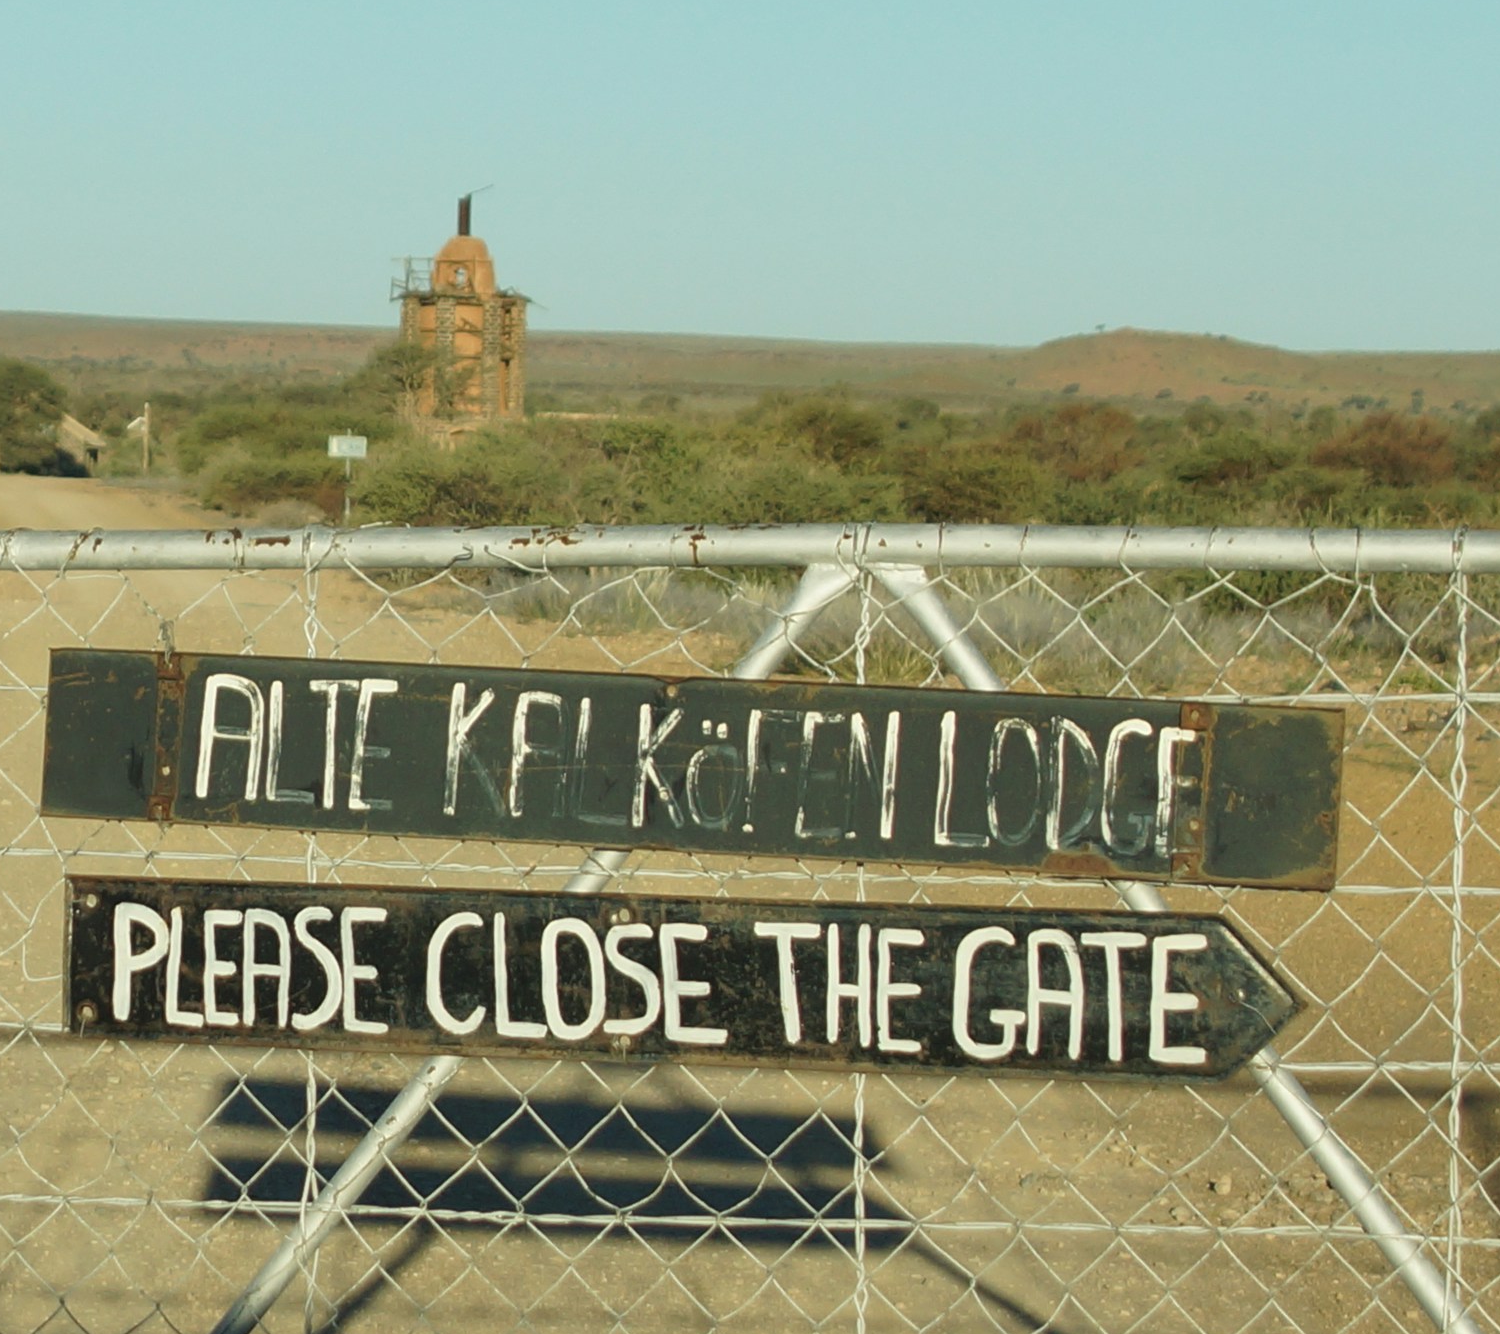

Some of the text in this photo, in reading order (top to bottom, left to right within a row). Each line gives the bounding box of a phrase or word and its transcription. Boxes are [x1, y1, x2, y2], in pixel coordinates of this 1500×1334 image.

[195, 673, 399, 811] ALTE
[934, 710, 1198, 859] LODGE
[112, 902, 1210, 1065] PLEASE CLOSE THE GATE
